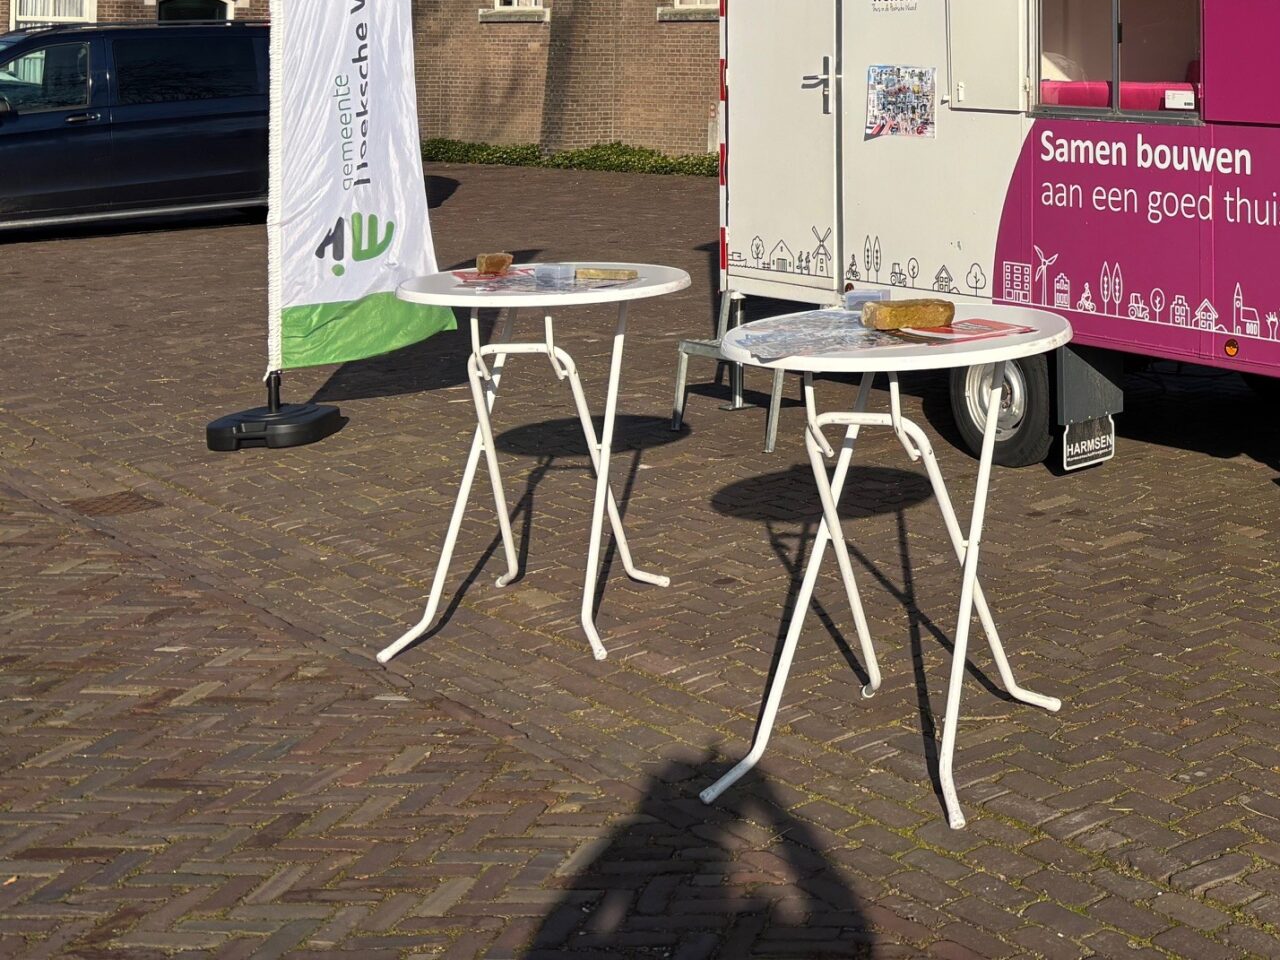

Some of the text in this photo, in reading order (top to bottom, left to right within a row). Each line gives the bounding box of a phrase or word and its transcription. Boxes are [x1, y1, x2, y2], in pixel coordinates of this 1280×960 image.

[333, 73, 353, 191] gemeente
[1040, 130, 1251, 175] Samen bouwen
[1041, 181, 1082, 208] aan
[1092, 185, 1138, 213] een
[1147, 185, 1213, 224] goed
[1066, 434, 1113, 457] HARMSEN
